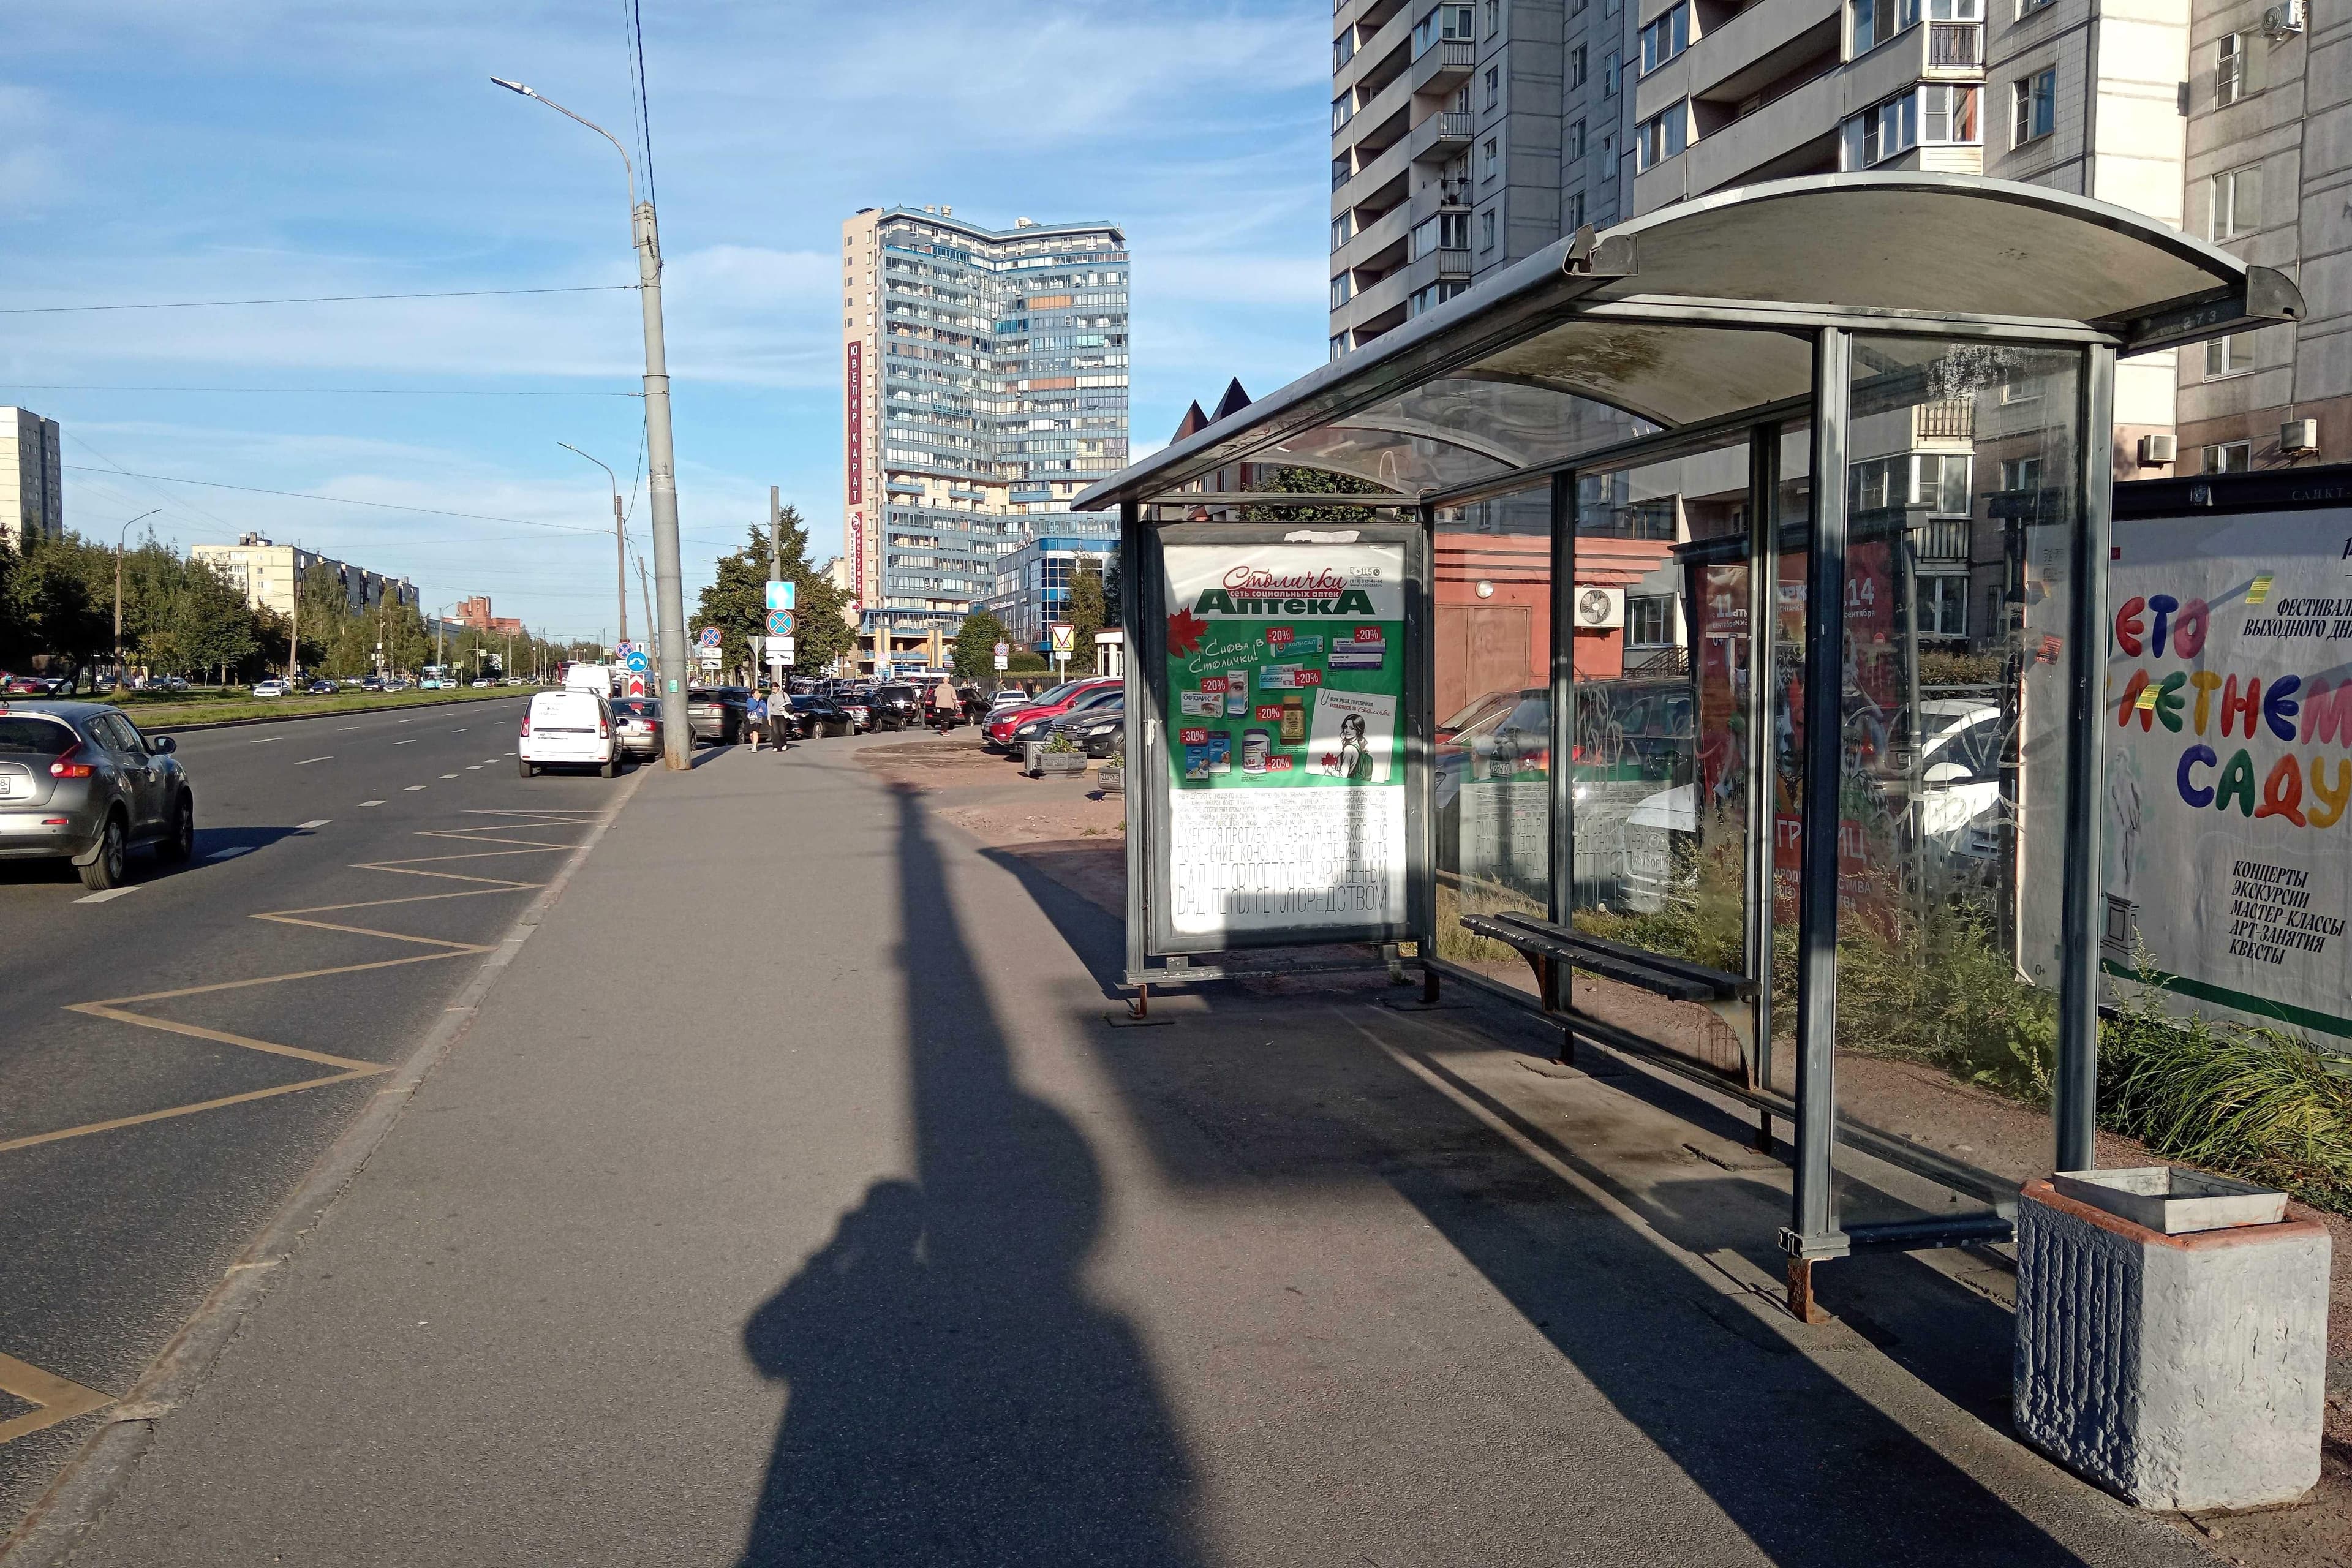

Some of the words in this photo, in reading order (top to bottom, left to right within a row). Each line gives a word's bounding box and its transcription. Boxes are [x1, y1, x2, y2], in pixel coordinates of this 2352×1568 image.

[2341, 537, 2352, 560] 1
[1223, 565, 1348, 589] Столички
[1849, 578, 1874, 606] 14
[1844, 608, 1875, 620] сентября
[1268, 629, 1291, 641] -20%
[1356, 628, 1378, 640] -20%
[2109, 594, 2210, 660] ЕТО
[2243, 619, 2326, 641] ВЫХОДНОГО
[1204, 680, 1226, 691] -20%
[1297, 673, 1319, 684] -20%
[1257, 707, 1280, 718] -20%
[2119, 668, 2352, 748] ЛЕТНЕМ
[1182, 731, 1204, 742] -30%
[1268, 758, 1289, 769] -20%
[2177, 744, 2351, 829] САДУ
[2233, 860, 2309, 888] КОНЦЕРТЫ
[1231, 862, 1294, 914] ЯВЛЯЕТСЯ
[1298, 886, 1387, 915] СРЕДСТВОМ
[2231, 880, 2310, 909] ЭКСКУРСИИ
[2230, 899, 2346, 937] МАСТЕР-КЛАССЫ
[2229, 919, 2327, 954] АРТ-ЗАНЯТИЯ
[2229, 938, 2286, 965] КВЕСТЫ
